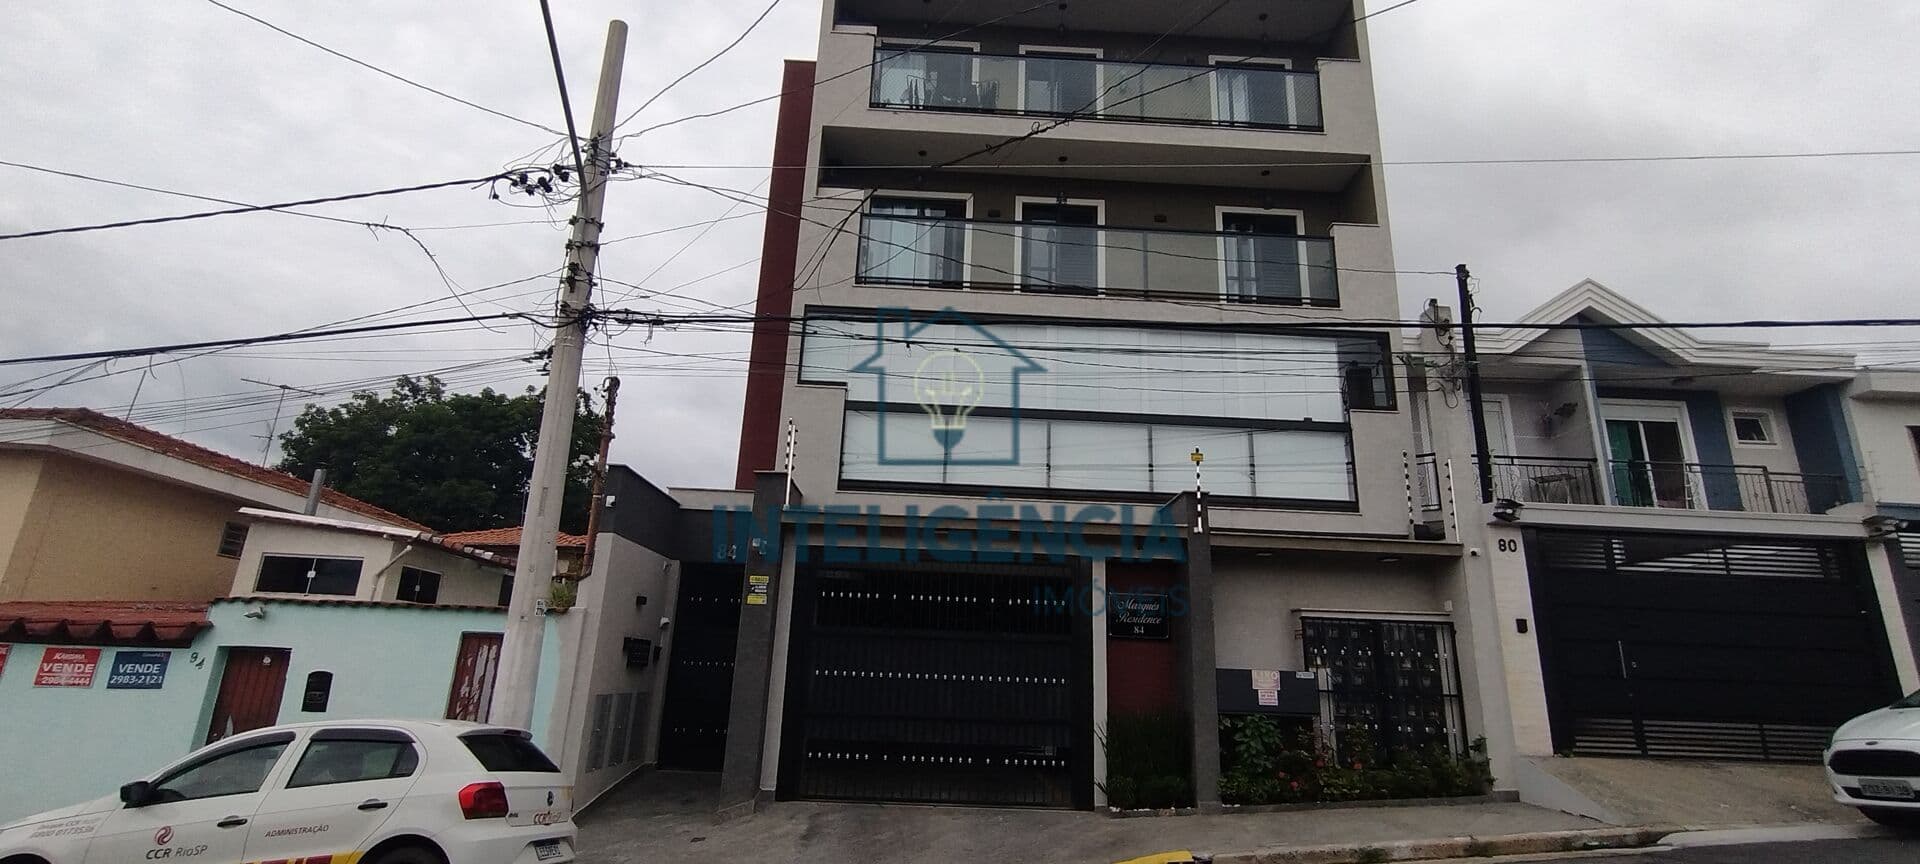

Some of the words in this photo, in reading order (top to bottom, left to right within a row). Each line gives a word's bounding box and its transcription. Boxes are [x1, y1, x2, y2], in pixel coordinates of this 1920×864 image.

[1498, 538, 1517, 552] 80
[1115, 610, 1162, 625] Residence
[1133, 625, 1145, 634] 84
[42, 662, 95, 673] VENDE
[118, 663, 161, 674] VENDE
[109, 675, 163, 685] 2983-2121
[264, 824, 329, 838] ADMINISTRAÇÃO
[145, 847, 172, 860] CCR
